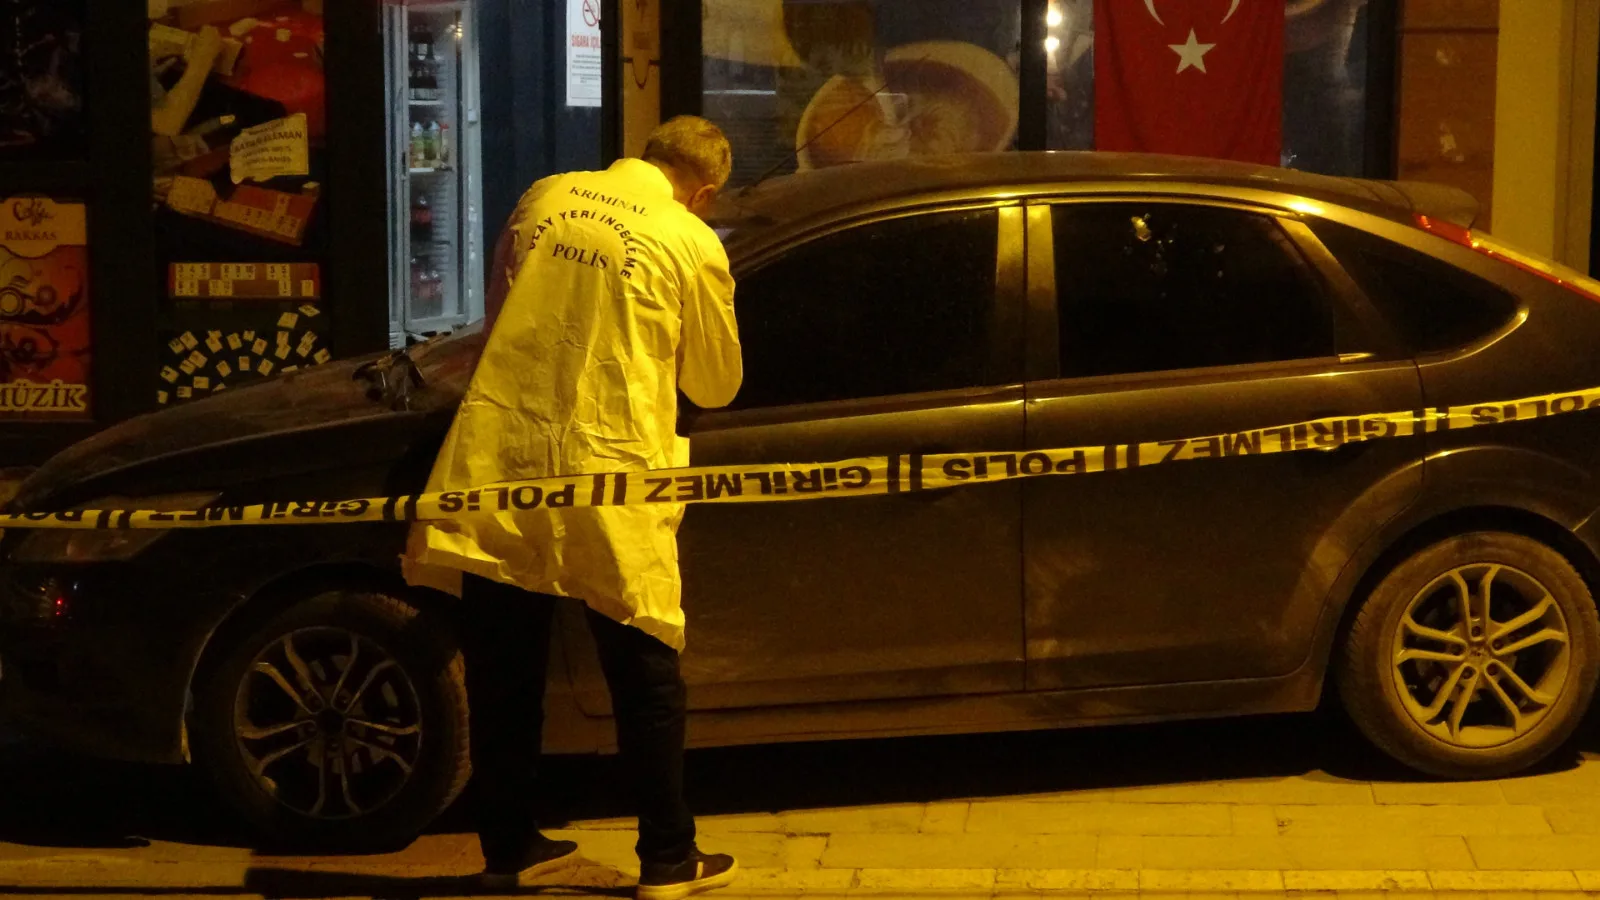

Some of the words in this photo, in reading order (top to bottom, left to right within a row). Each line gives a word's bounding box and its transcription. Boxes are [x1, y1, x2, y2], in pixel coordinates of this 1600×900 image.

[569, 186, 648, 217] KRİMİNAL
[559, 210, 597, 221] YERİ
[552, 243, 609, 269] POLİS
